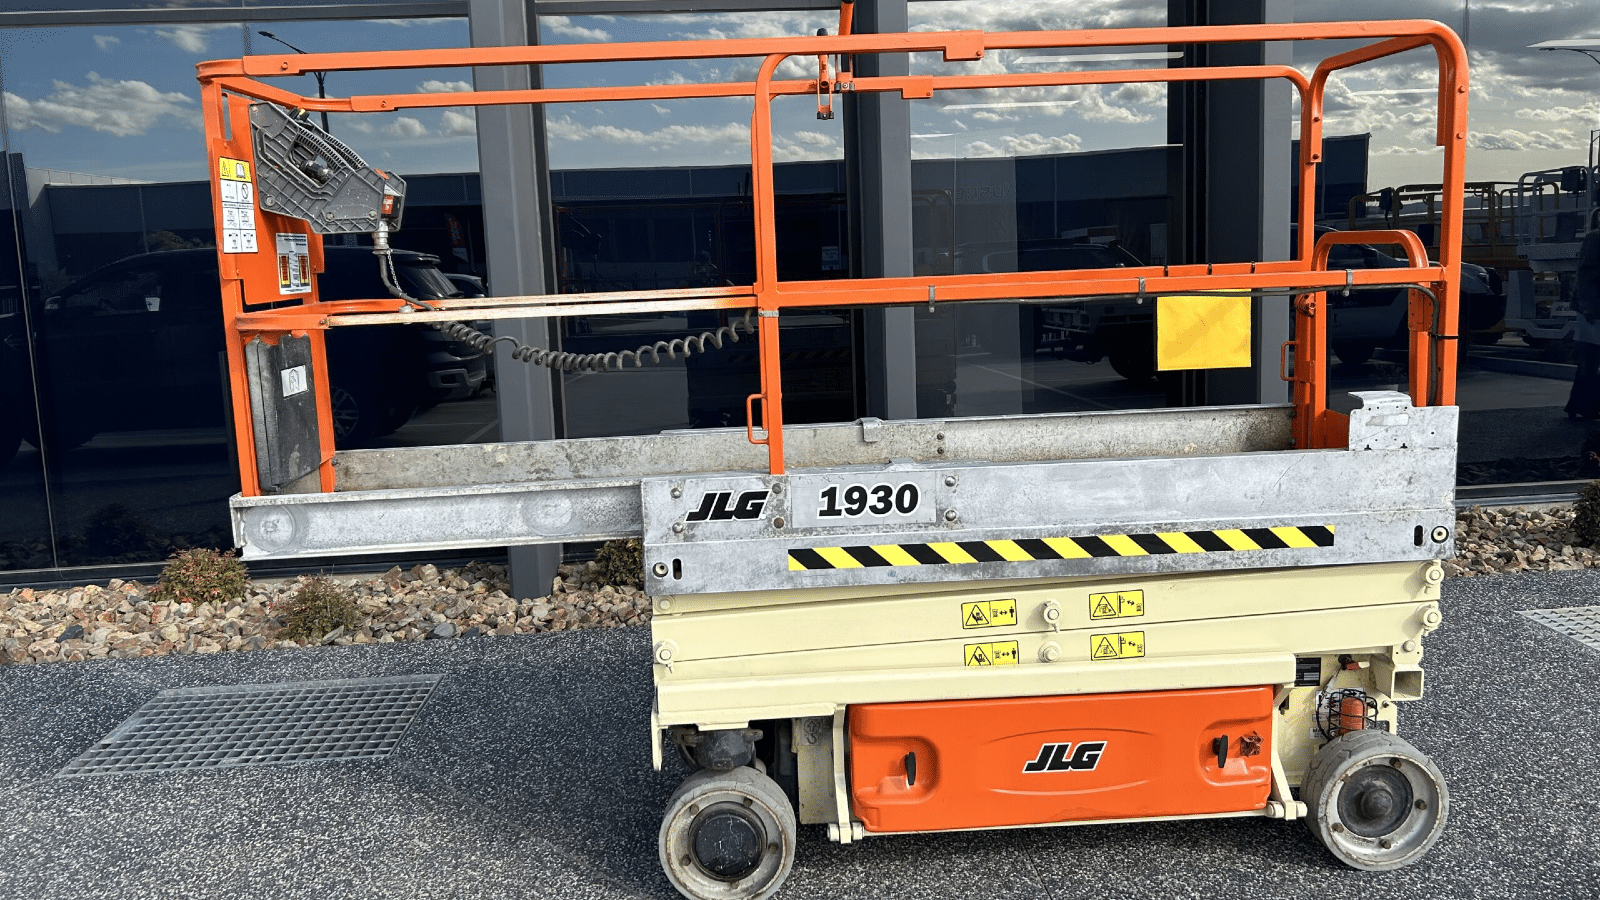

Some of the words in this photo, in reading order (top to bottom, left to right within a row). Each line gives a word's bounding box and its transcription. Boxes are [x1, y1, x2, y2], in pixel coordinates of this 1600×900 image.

[685, 490, 770, 522] JLG
[818, 483, 919, 517] 1930
[1023, 742, 1107, 772] JLG
